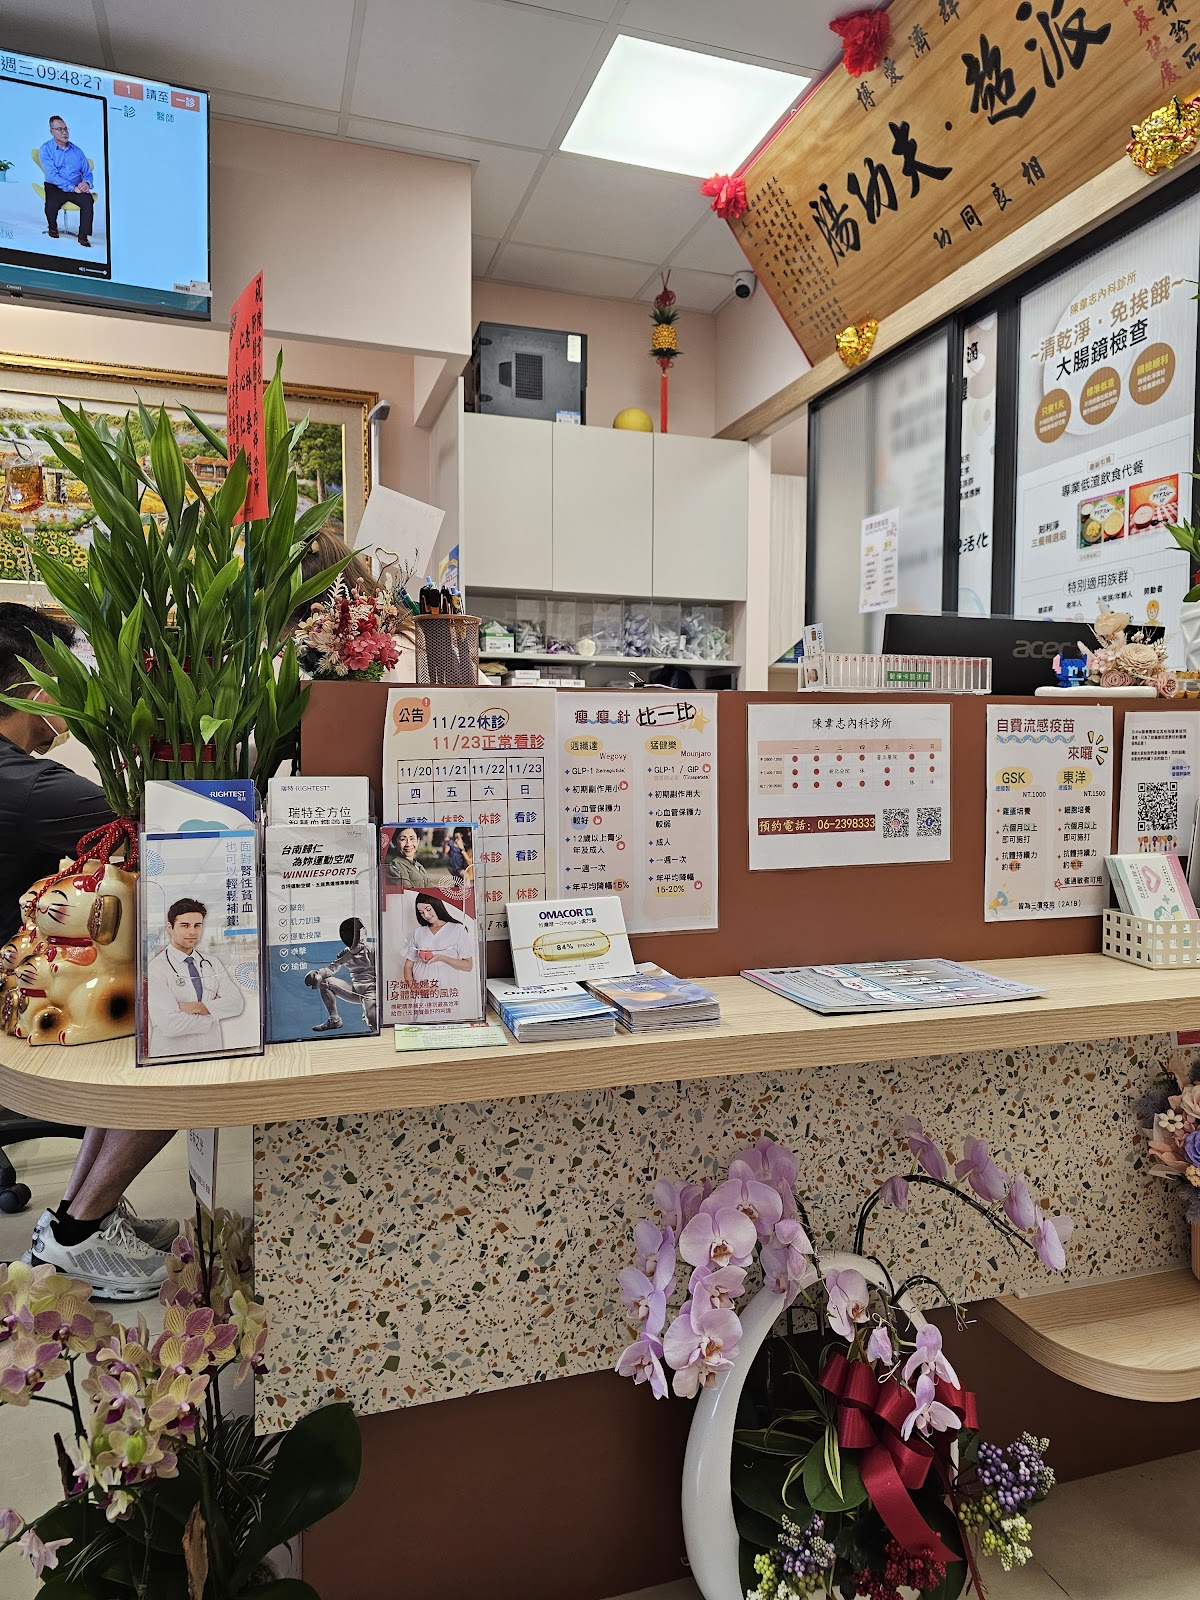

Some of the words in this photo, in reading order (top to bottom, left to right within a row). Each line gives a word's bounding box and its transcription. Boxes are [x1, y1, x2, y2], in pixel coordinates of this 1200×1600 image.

[146, 88, 169, 104] 請至
[174, 96, 195, 108] 一診
[110, 104, 136, 119] 一診
[156, 111, 175, 123] 醫師
[1056, 317, 1148, 381] 大腸鏡檢查
[1061, 459, 1144, 498] 專業低渣飲食代餐
[959, 532, 988, 555] 活化
[1067, 569, 1129, 594] 特別適用族群
[1012, 640, 1071, 659] acer
[399, 707, 424, 723] 公告
[574, 709, 631, 724] 瘦瘦針
[638, 701, 695, 726] 比一比
[432, 715, 506, 730] 11/22休診
[811, 717, 893, 730] 陳韋志內科診所
[997, 718, 1075, 733] 自費流感疫苗
[433, 734, 545, 751] 11/23正常看診
[650, 740, 677, 750] 猛健樂
[599, 752, 627, 761] Wegovy
[680, 750, 711, 758] Mounjaro
[1068, 745, 1093, 760] 來囉
[400, 766, 432, 777] 11/20
[435, 764, 467, 776] 11/21
[472, 764, 505, 775] 11/22
[509, 763, 542, 774] 11/23
[571, 767, 593, 775] GLP-1
[1001, 772, 1026, 784] GSK
[1063, 770, 1086, 784] 東洋
[210, 790, 247, 798] RIGHTEST
[410, 788, 421, 799] 四
[446, 786, 457, 798] 五
[483, 785, 494, 796] 六
[520, 784, 530, 795] 日
[572, 784, 619, 794] 初期副作用小
[654, 789, 701, 799] 初期副作用大
[288, 806, 351, 819] 瑞特全方位
[572, 804, 621, 813] 心血管保護力
[655, 808, 702, 817] 心血管保護力
[1002, 807, 1031, 816] 雞蛋培養
[1064, 806, 1091, 814] 細胞培養
[478, 813, 501, 825] 休診
[514, 812, 537, 823] 看診
[572, 816, 589, 825] 較好
[655, 820, 671, 829] 較弱
[817, 817, 876, 830] 06-2398333
[1002, 823, 1038, 832] 六個月以上
[1063, 821, 1097, 830] 六個月以上
[655, 838, 671, 847] 成人
[1002, 835, 1031, 844] 即可施打
[1063, 833, 1090, 842] 即可施打
[281, 843, 324, 856] 台南歸仁
[572, 846, 605, 854] 年及成人
[1001, 851, 1038, 860] 抗體持續力
[1063, 849, 1097, 858] 抗體持續力
[292, 853, 355, 867] 為妳運動空間
[479, 851, 502, 863] 休診
[515, 850, 538, 862] 看診
[656, 855, 687, 864] 一週一次
[573, 864, 606, 873] 一週一次
[1001, 862, 1022, 871] 約半年
[1062, 860, 1083, 869] 約半年
[282, 867, 358, 879] WINNIESPORTS
[656, 873, 695, 882] 年平均降幅
[516, 888, 539, 900] 休診
[656, 885, 685, 893] 15-20%
[538, 908, 584, 920] OMACOR
[556, 943, 574, 951] 84%
[389, 978, 439, 990] 孕婦及婦女
